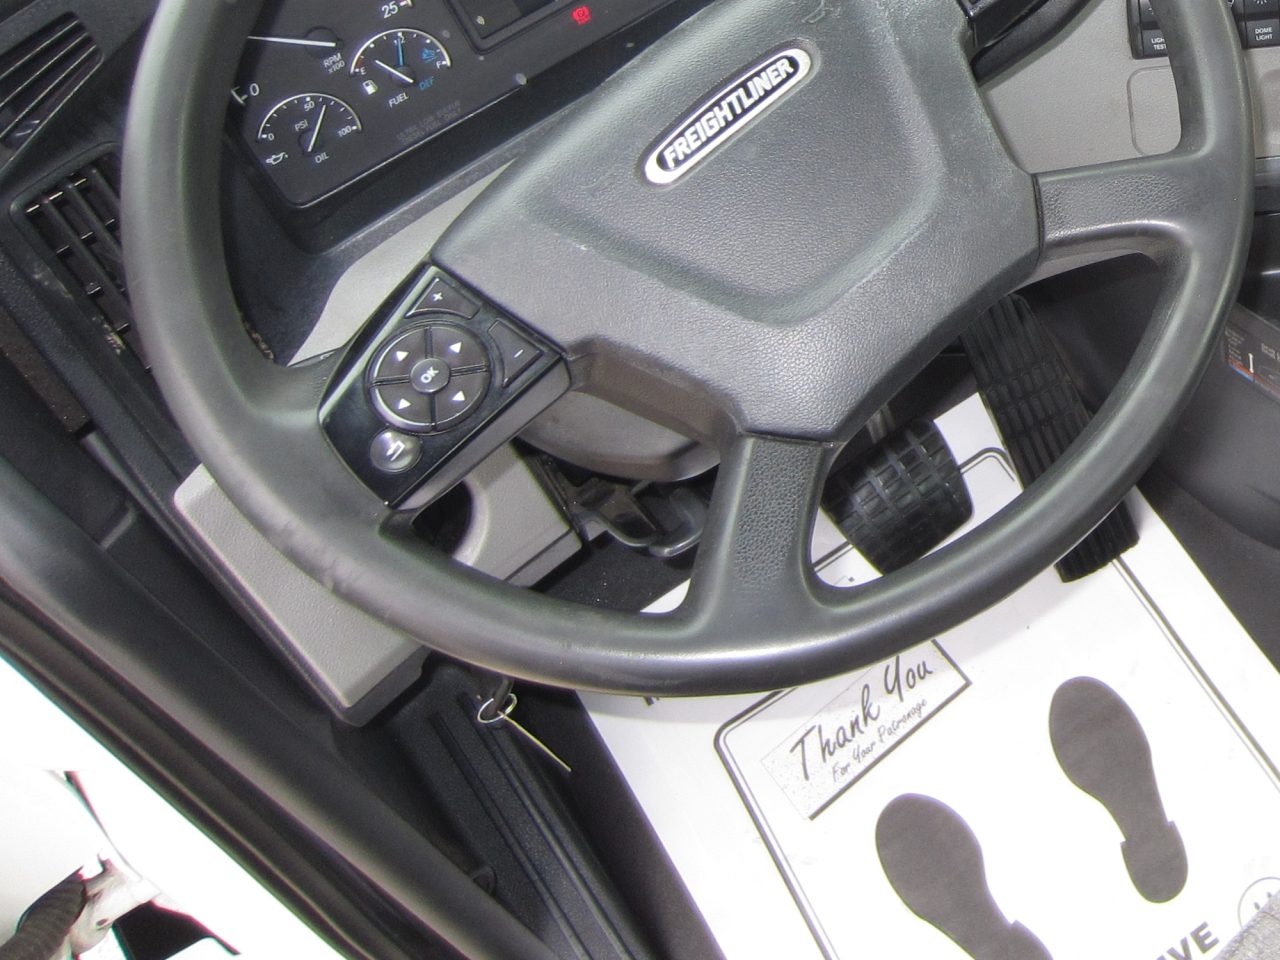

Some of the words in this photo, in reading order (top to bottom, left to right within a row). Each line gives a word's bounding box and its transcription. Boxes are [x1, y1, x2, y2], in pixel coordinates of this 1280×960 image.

[381, 0, 399, 19] 25
[323, 52, 343, 69] RPM
[327, 59, 346, 75] x100
[359, 66, 367, 76] E
[303, 100, 315, 112] 50
[388, 92, 409, 108] FUEL
[663, 58, 794, 169] FREIGHTLINER
[294, 119, 309, 132] PSI
[338, 125, 353, 138] 100
[314, 151, 330, 164] OIL
[420, 366, 440, 384] OK
[790, 683, 880, 781] Thank
[884, 654, 933, 702] You
[832, 761, 850, 782] For
[852, 740, 876, 764] Your
[877, 699, 928, 744] Patronage
